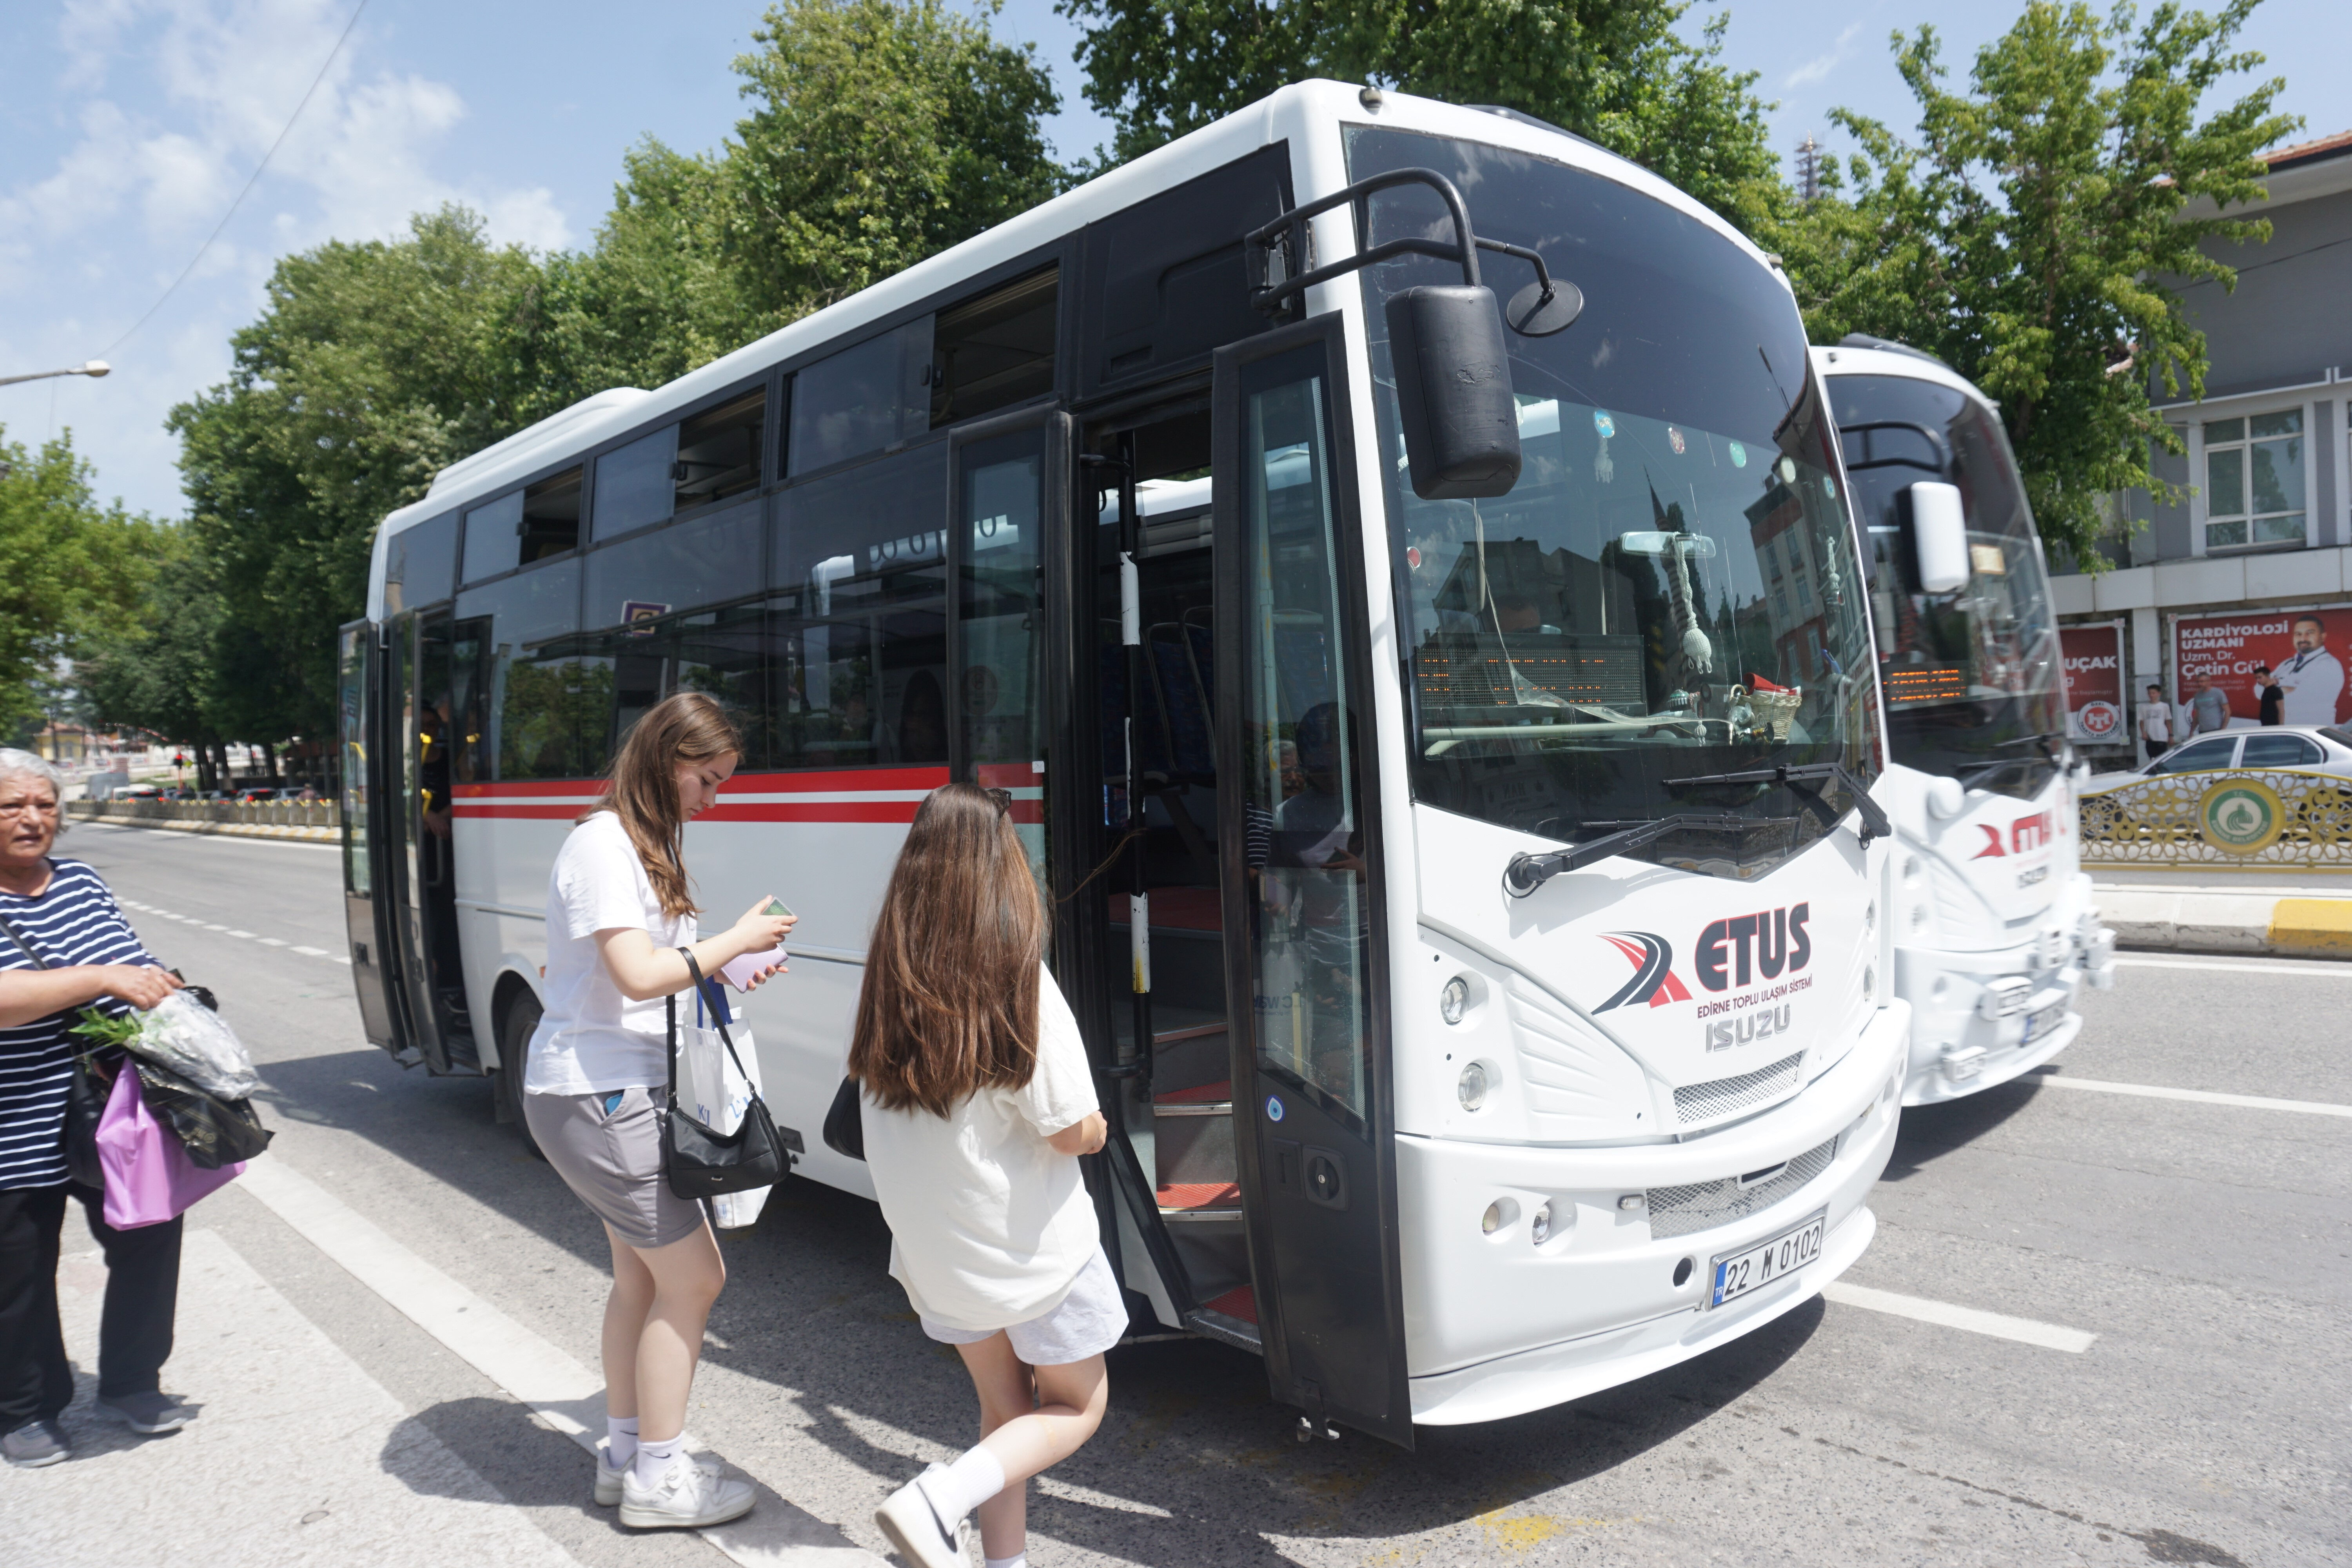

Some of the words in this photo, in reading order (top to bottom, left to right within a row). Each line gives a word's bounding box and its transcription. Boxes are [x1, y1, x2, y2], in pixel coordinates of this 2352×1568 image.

[2181, 619, 2288, 639] KARDİYOLOJİ
[2182, 637, 2244, 650] UZMANI
[2181, 661, 2229, 681] Çetin
[2182, 652, 2214, 662] Uzm.
[2217, 650, 2236, 661] Dr.
[1694, 901, 1811, 993] ETUS
[1697, 1000, 1730, 1018] EDİRNE
[1733, 992, 1759, 1010] TOPLU
[1761, 984, 1788, 1001] ULAŞIM
[1789, 973, 1812, 993] SİSTEMİ
[1706, 1003, 1791, 1053] ISUZU
[1715, 1286, 1724, 1297] TR
[1724, 1259, 1750, 1296] 22
[1761, 1247, 1774, 1280] M
[1780, 1225, 1819, 1270] 0102
